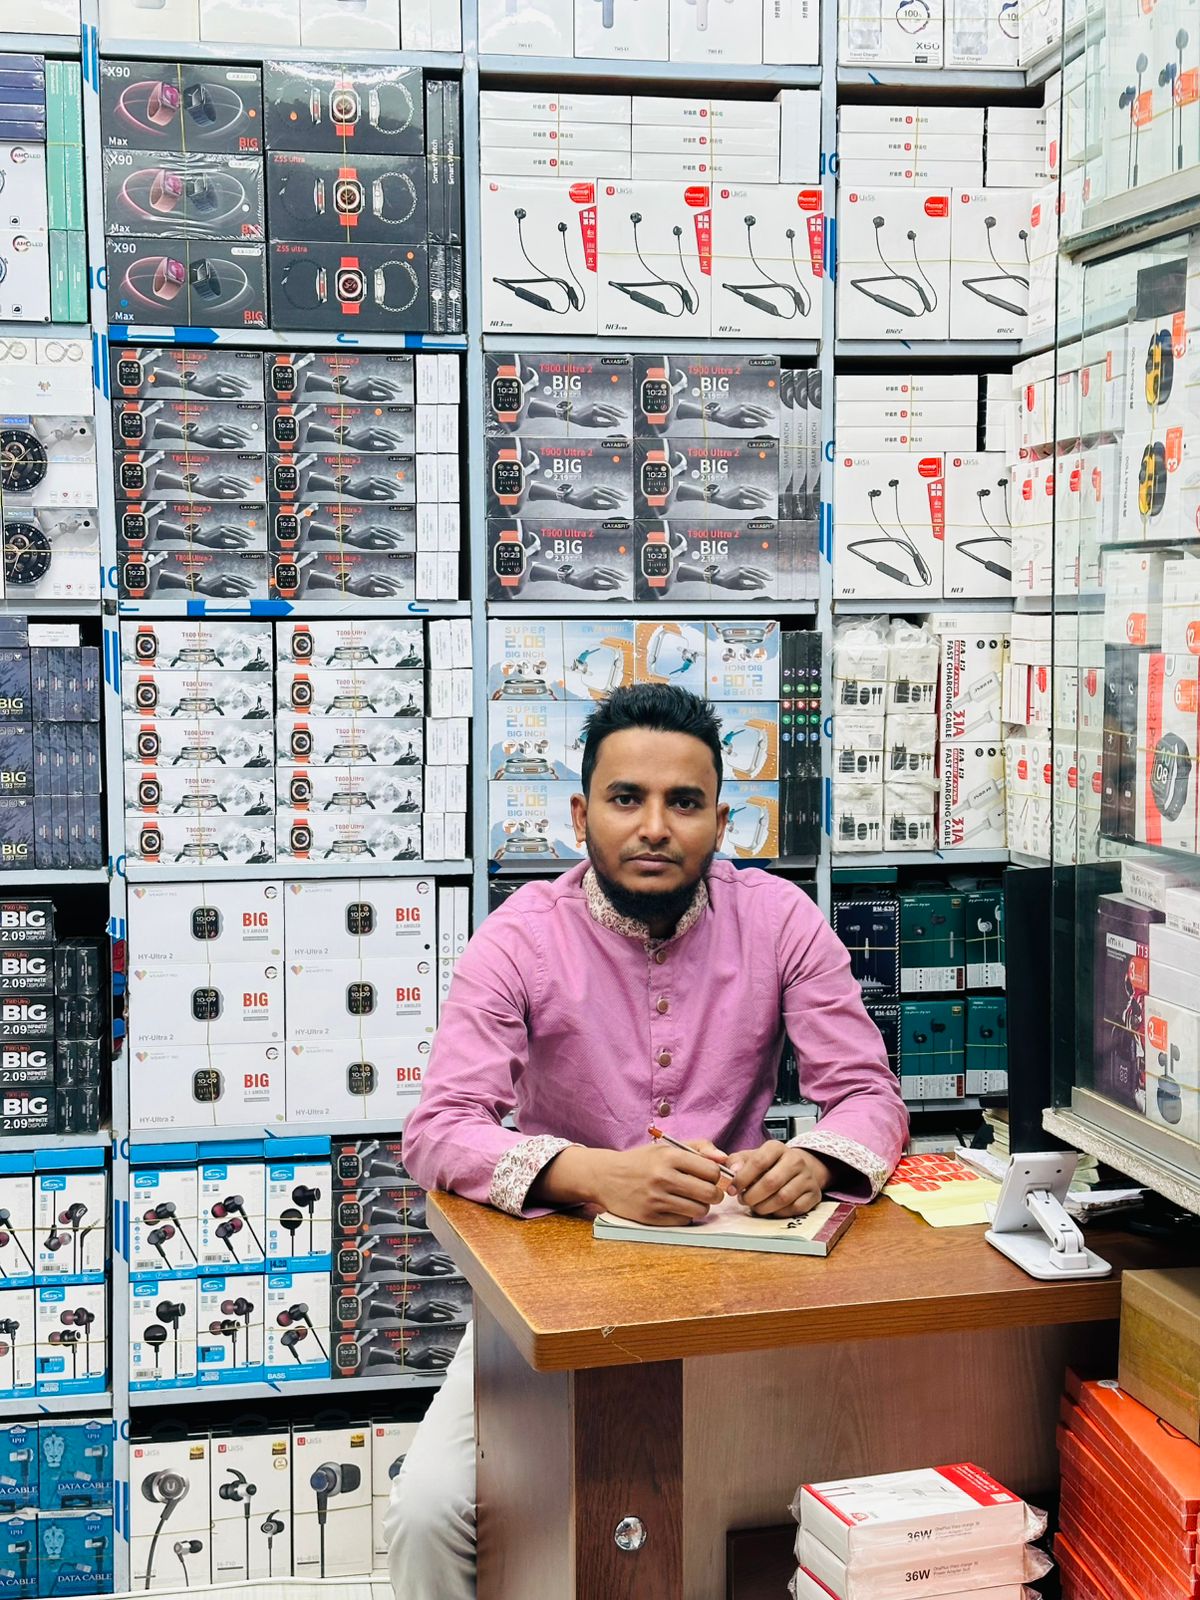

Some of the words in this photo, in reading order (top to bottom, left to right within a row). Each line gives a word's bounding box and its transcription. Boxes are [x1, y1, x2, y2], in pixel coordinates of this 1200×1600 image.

[107, 66, 131, 78] X90
[109, 136, 128, 146] Max
[240, 137, 259, 147] BIG
[110, 154, 133, 166] X90
[111, 223, 130, 234] Max
[113, 243, 137, 254] X90
[115, 311, 134, 322] Max
[243, 311, 263, 321] BIG
[552, 376, 581, 390] BIG
[701, 377, 729, 391] BIG
[553, 459, 582, 473] BIG
[701, 460, 728, 473] BIG
[554, 540, 583, 553] BIG
[701, 541, 728, 554] BIG
[505, 626, 546, 634] SUPER
[1127, 618, 1135, 637] 12
[1187, 628, 1195, 647] 12
[505, 651, 522, 659] BIG
[523, 651, 544, 659] INCH
[945, 662, 953, 710] CHARGING
[1175, 690, 1182, 705] 6
[507, 705, 547, 713] SUPER
[953, 709, 966, 738] 3.1A
[945, 748, 953, 768] FAST
[1, 772, 26, 782] BIG
[507, 785, 548, 793] SUPER
[952, 817, 965, 845] 3.1A
[2, 844, 28, 855] BIG
[1, 910, 46, 927] BIG
[242, 912, 268, 927] BIG
[395, 907, 420, 922] BIG
[1, 931, 26, 941] 2.09
[1136, 944, 1149, 959] T13
[2, 958, 47, 975] BIG
[1130, 961, 1136, 981] 3
[2, 978, 27, 988] 2.09
[243, 992, 268, 1007] BIG
[396, 987, 421, 1001] BIG
[2, 1004, 47, 1021] BIG
[2, 1025, 27, 1034] 2.09
[1149, 1021, 1155, 1040] 3
[3, 1051, 48, 1068] BIG
[3, 1072, 27, 1082] 2.09
[244, 1073, 269, 1088] BIG
[397, 1067, 421, 1081] BIG
[3, 1098, 48, 1115] BIG
[3, 1119, 28, 1129] 2.09
[7, 1486, 38, 1494] CABLE
[58, 1482, 82, 1491] DATA
[83, 1481, 112, 1490] CABLE
[906, 1529, 933, 1543] 36W
[58, 1574, 82, 1583] DATA
[83, 1573, 112, 1582] CABLE
[905, 1569, 930, 1583] 36W
